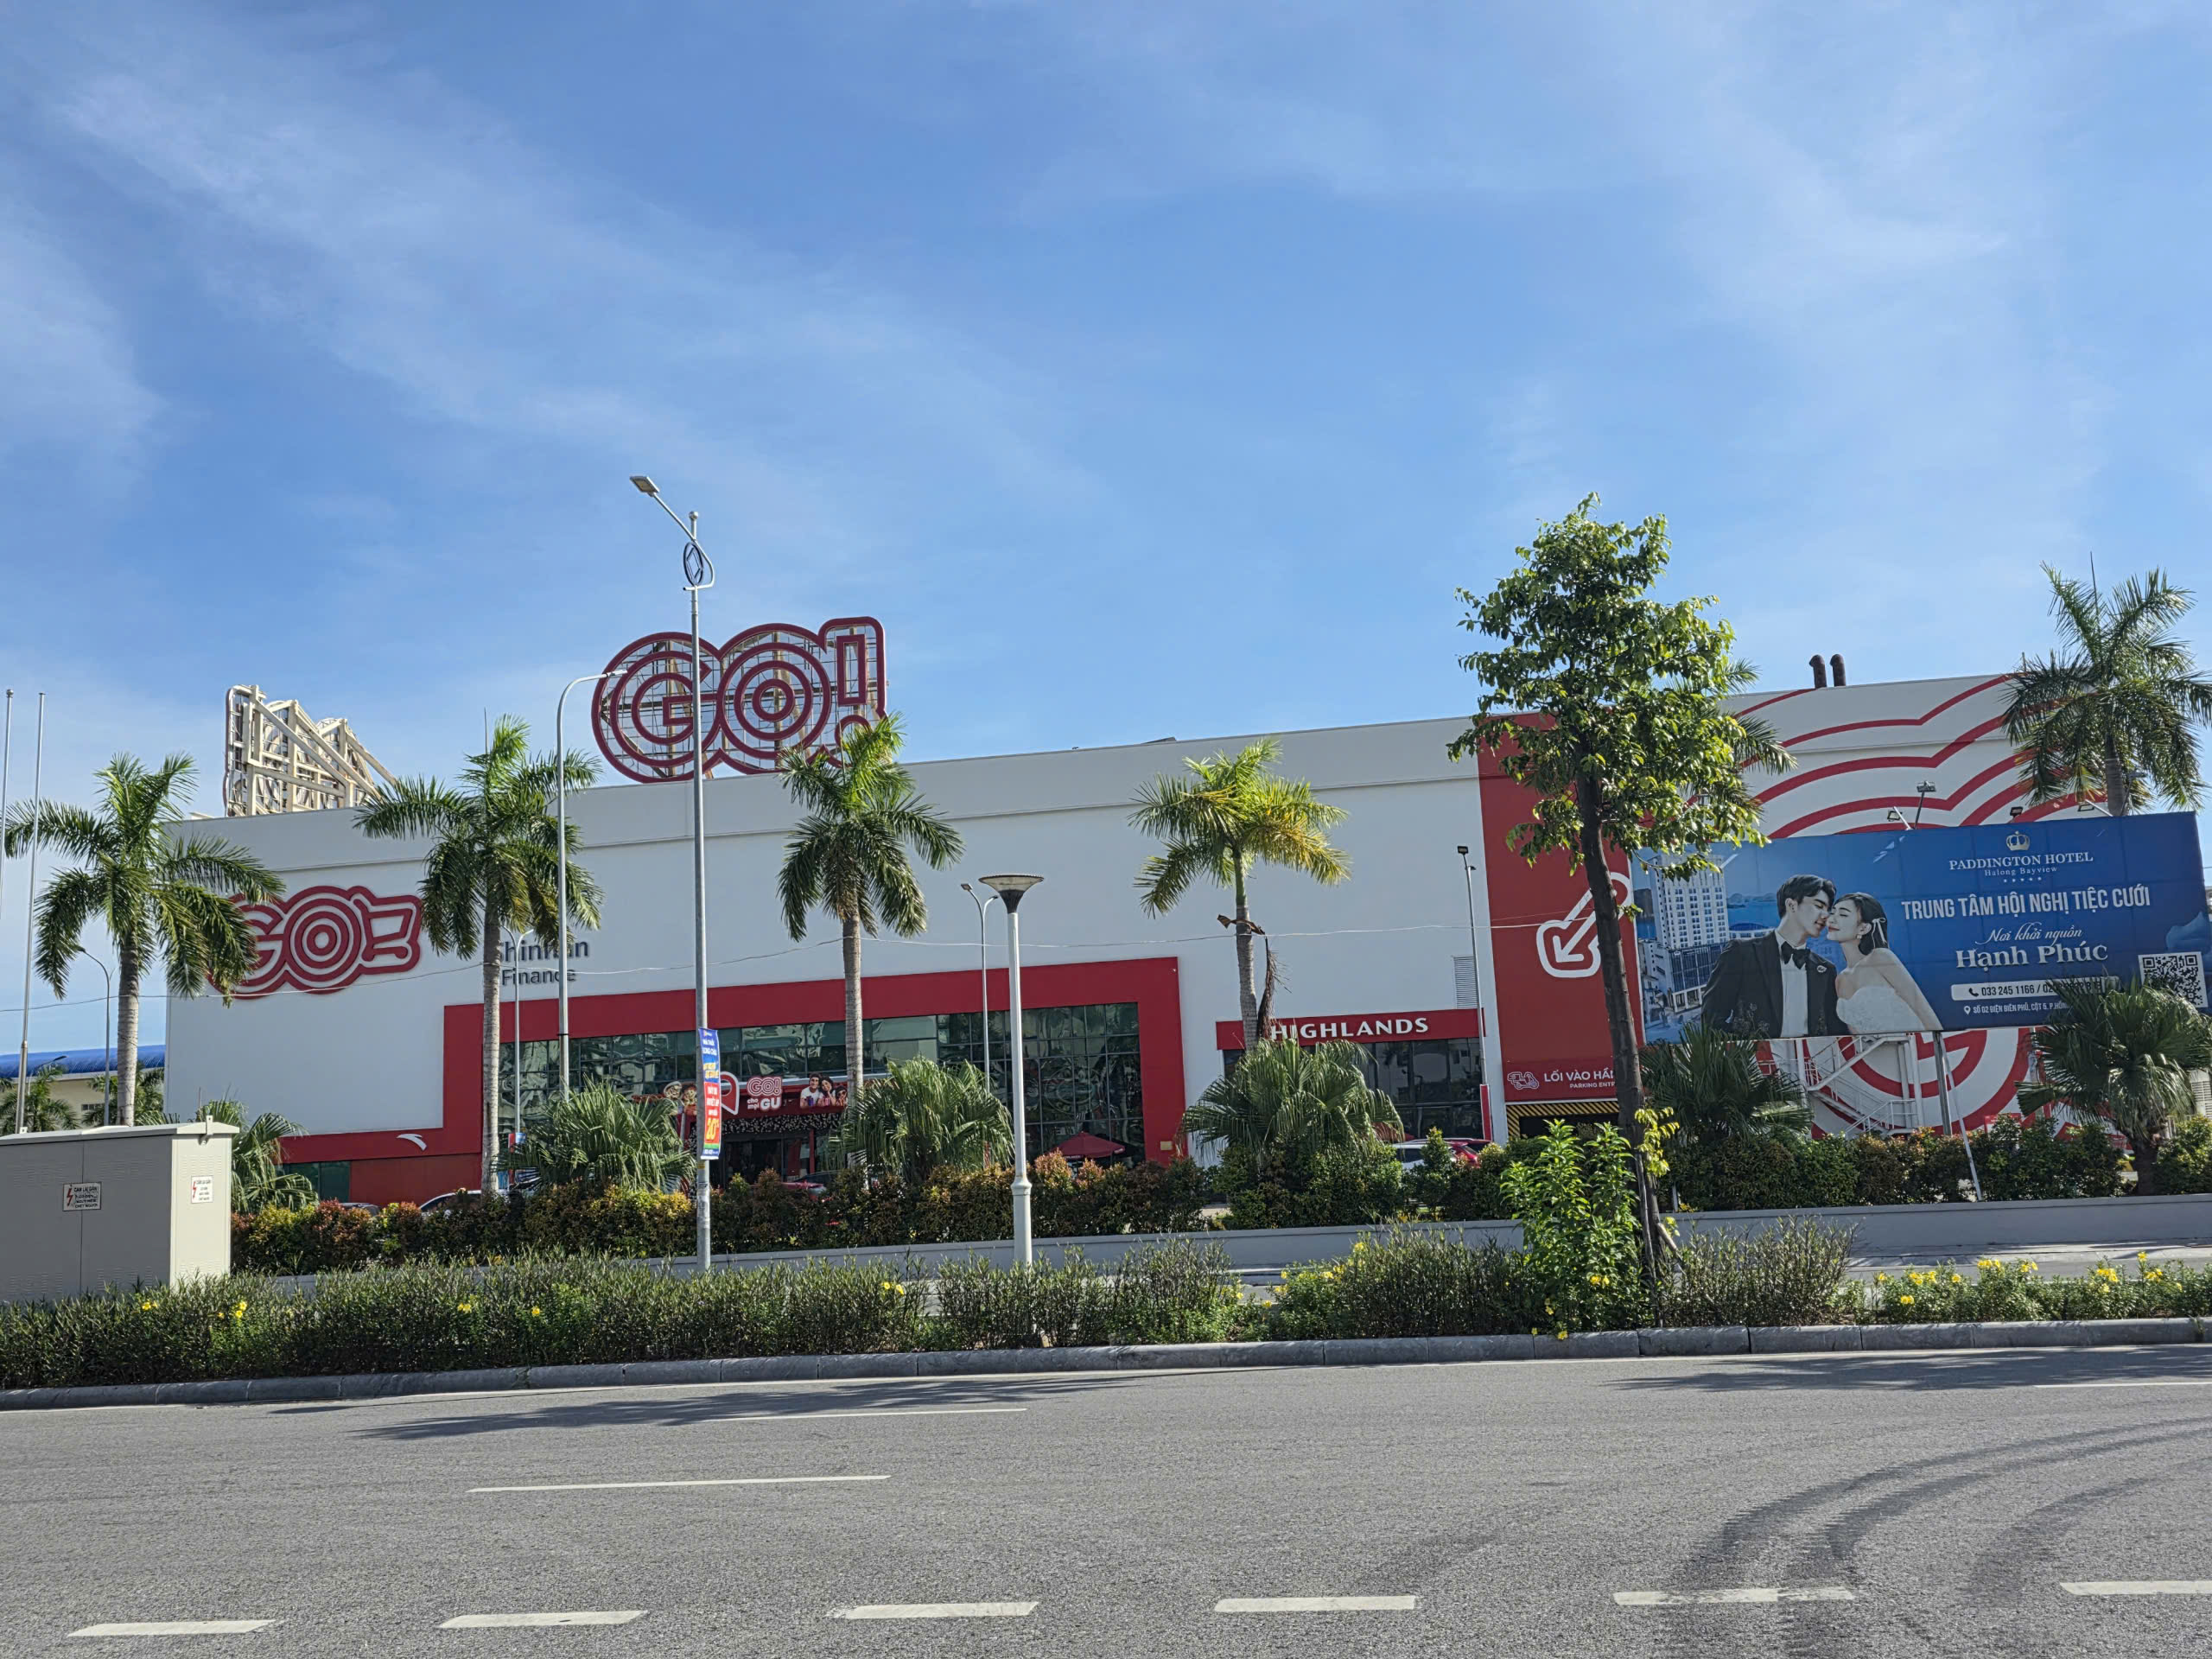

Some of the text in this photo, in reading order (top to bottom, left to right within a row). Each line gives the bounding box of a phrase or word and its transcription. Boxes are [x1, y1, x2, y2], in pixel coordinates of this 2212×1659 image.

[1948, 852, 2093, 870] PADDINGTON HOTEL
[1985, 866, 2057, 876] Halong Bayview
[1902, 883, 2151, 920] TRUNG TÂM HỘI NGHỊ TIỆC CƯỚI
[1975, 922, 2082, 947] Nơi khởi nguồn
[1955, 940, 2107, 971] Hạnh Phúc
[1981, 987, 1996, 996] 033
[1999, 985, 2013, 995] 245
[2016, 984, 2034, 995] 1166
[1271, 1017, 1429, 1039] HIGHLANDS
[1544, 1070, 1563, 1082] LỐI
[1566, 1070, 1591, 1081] VÀO
[760, 1097, 781, 1110] GU
